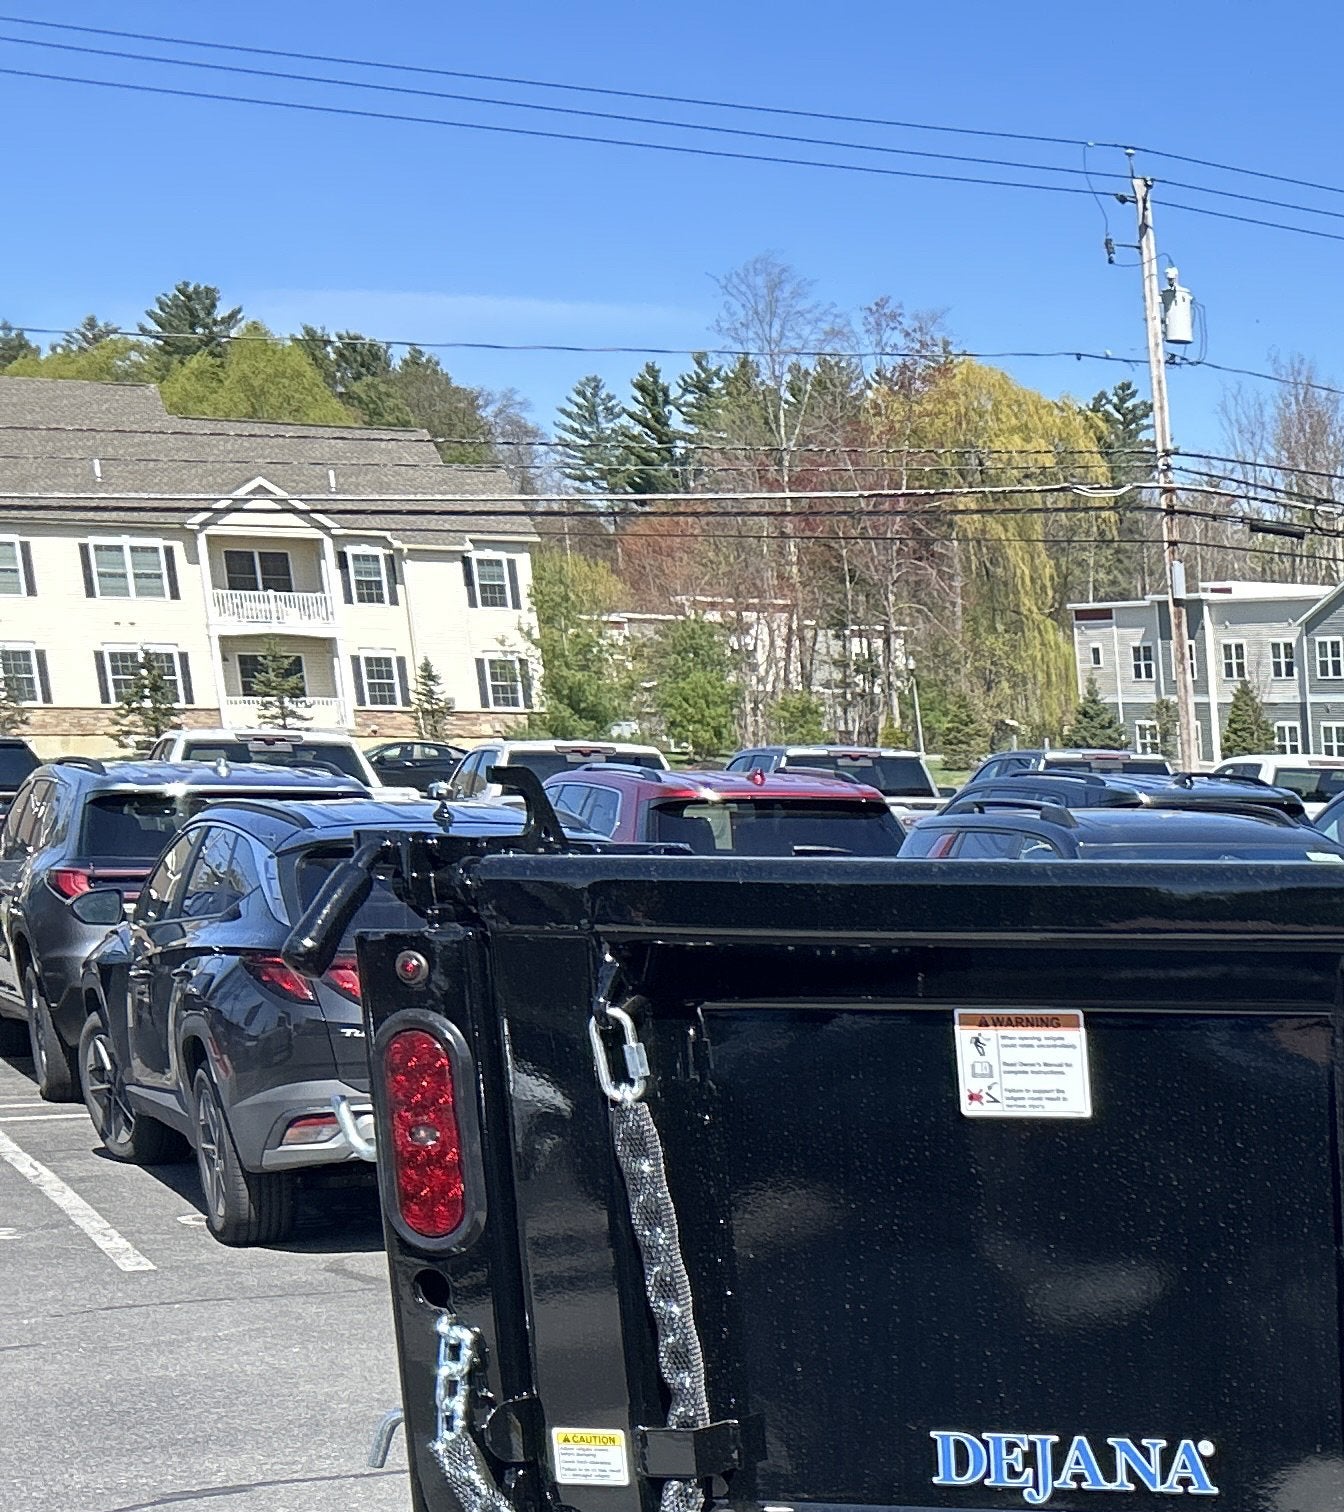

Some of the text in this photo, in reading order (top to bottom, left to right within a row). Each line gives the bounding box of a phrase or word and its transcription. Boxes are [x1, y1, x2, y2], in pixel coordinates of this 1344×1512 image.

[991, 1016, 1061, 1028] WARNING
[572, 1435, 616, 1445] CAUTION
[930, 1431, 1219, 1504] DEJANA
